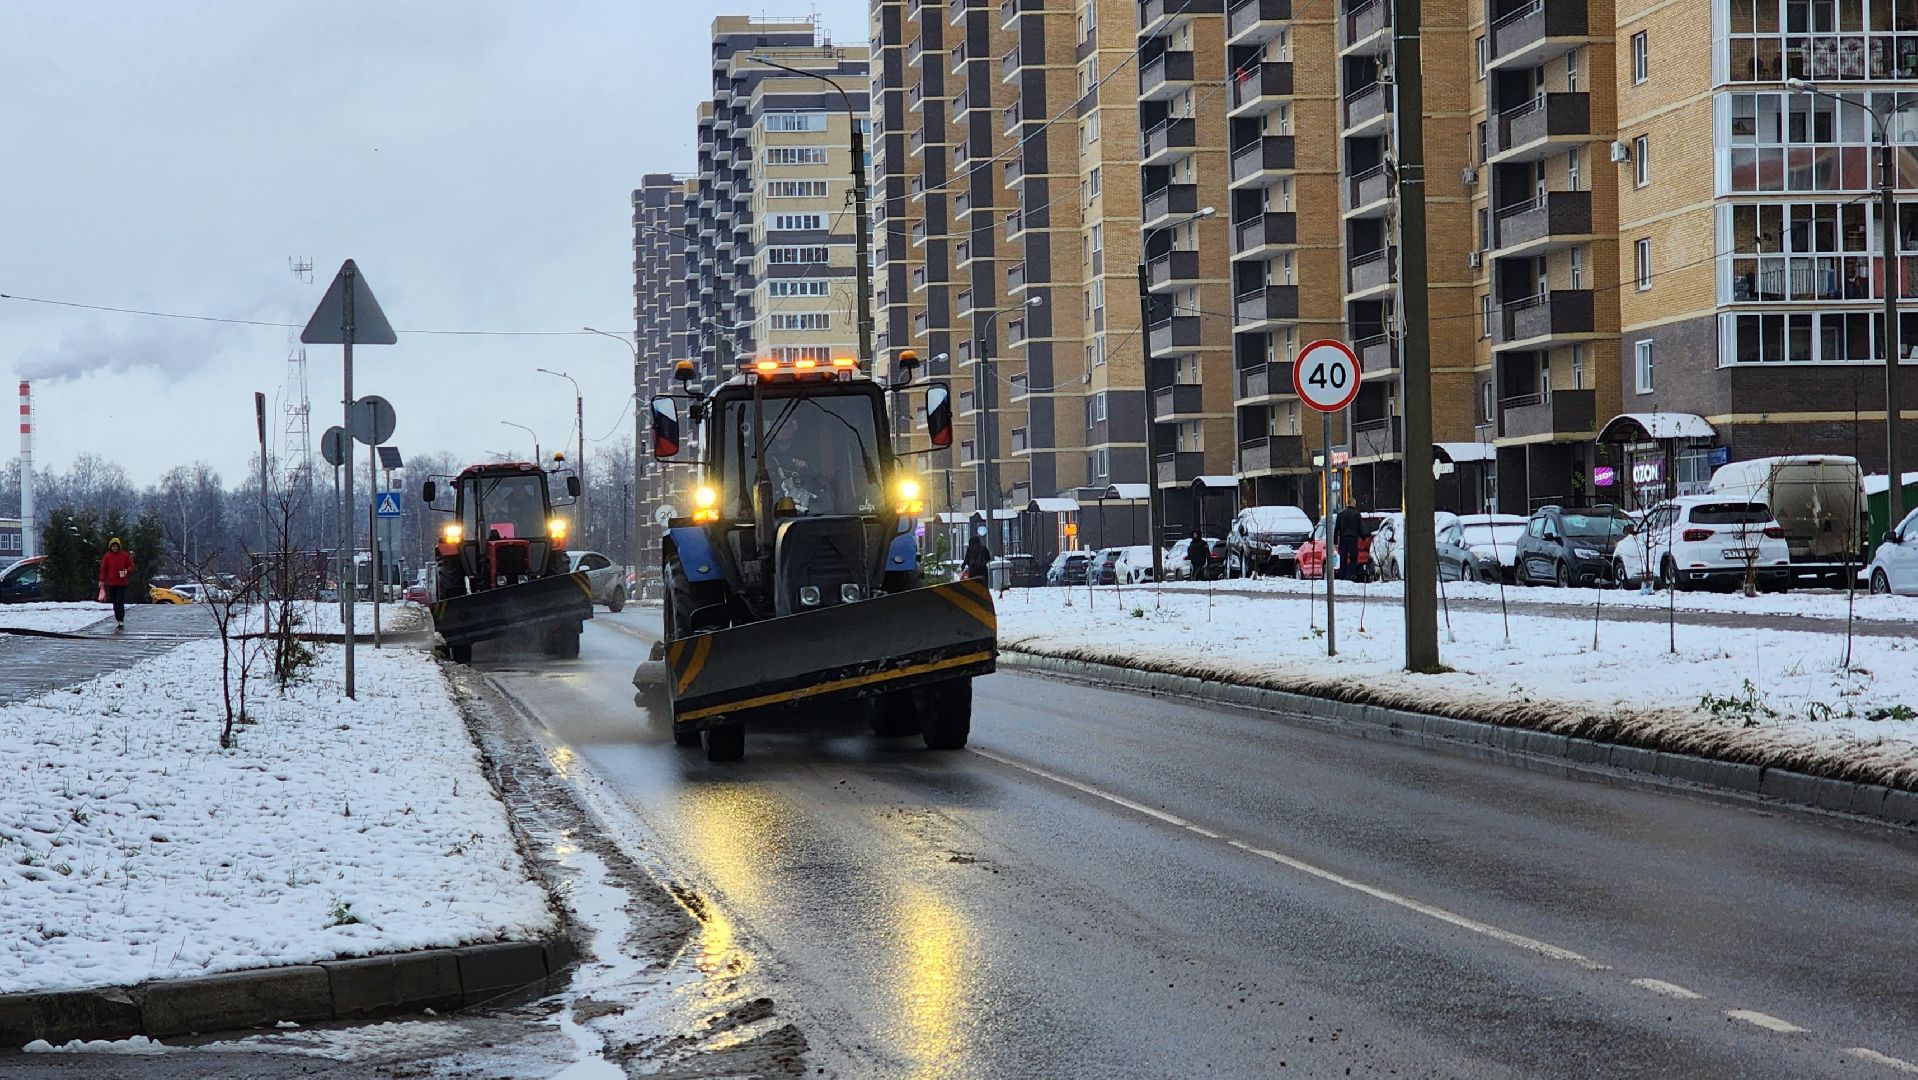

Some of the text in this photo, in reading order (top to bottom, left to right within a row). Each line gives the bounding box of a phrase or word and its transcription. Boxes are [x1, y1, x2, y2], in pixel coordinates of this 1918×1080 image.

[1309, 362, 1346, 389] 40
[1633, 464, 1658, 483] OZON
[660, 511, 672, 520] 20
